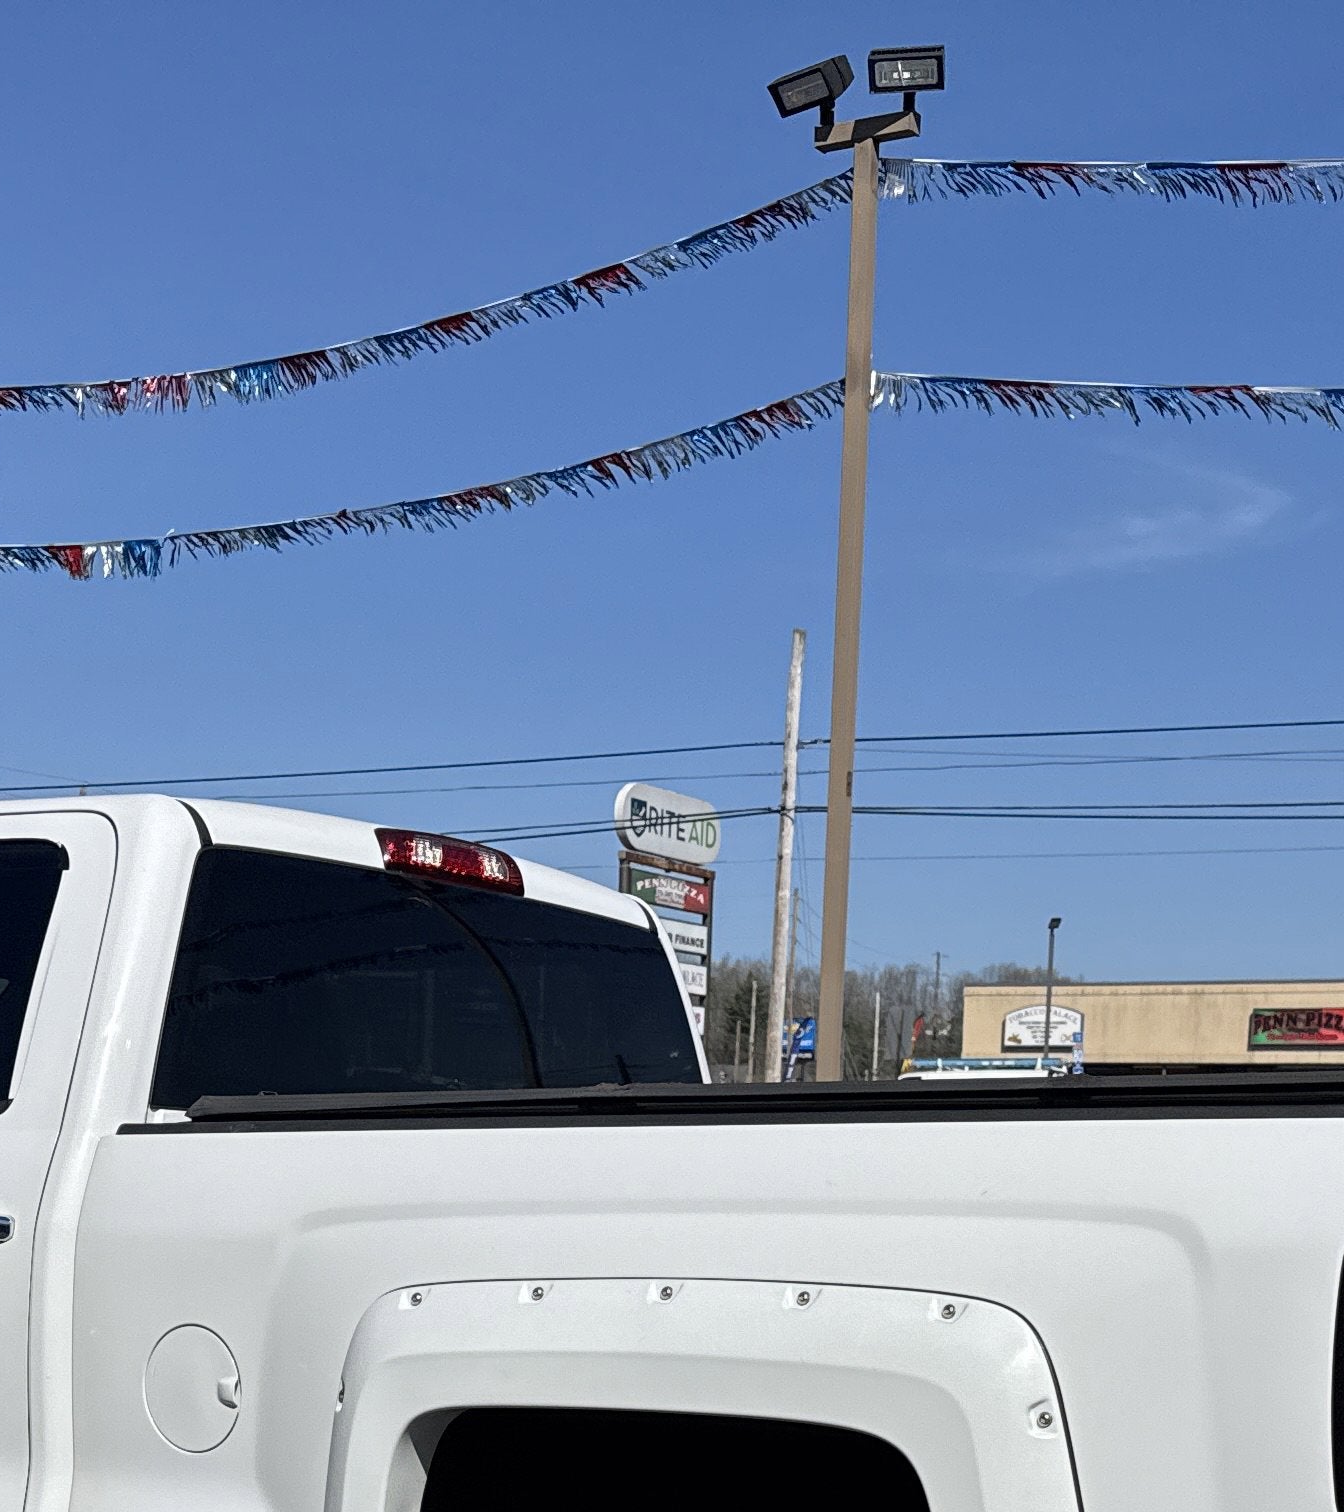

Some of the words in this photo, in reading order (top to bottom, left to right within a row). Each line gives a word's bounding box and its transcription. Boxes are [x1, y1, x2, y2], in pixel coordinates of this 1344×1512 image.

[648, 805, 686, 842] RITE
[688, 820, 717, 848] AID
[675, 933, 705, 949] FINANCE
[1053, 1009, 1079, 1025] ALACE
